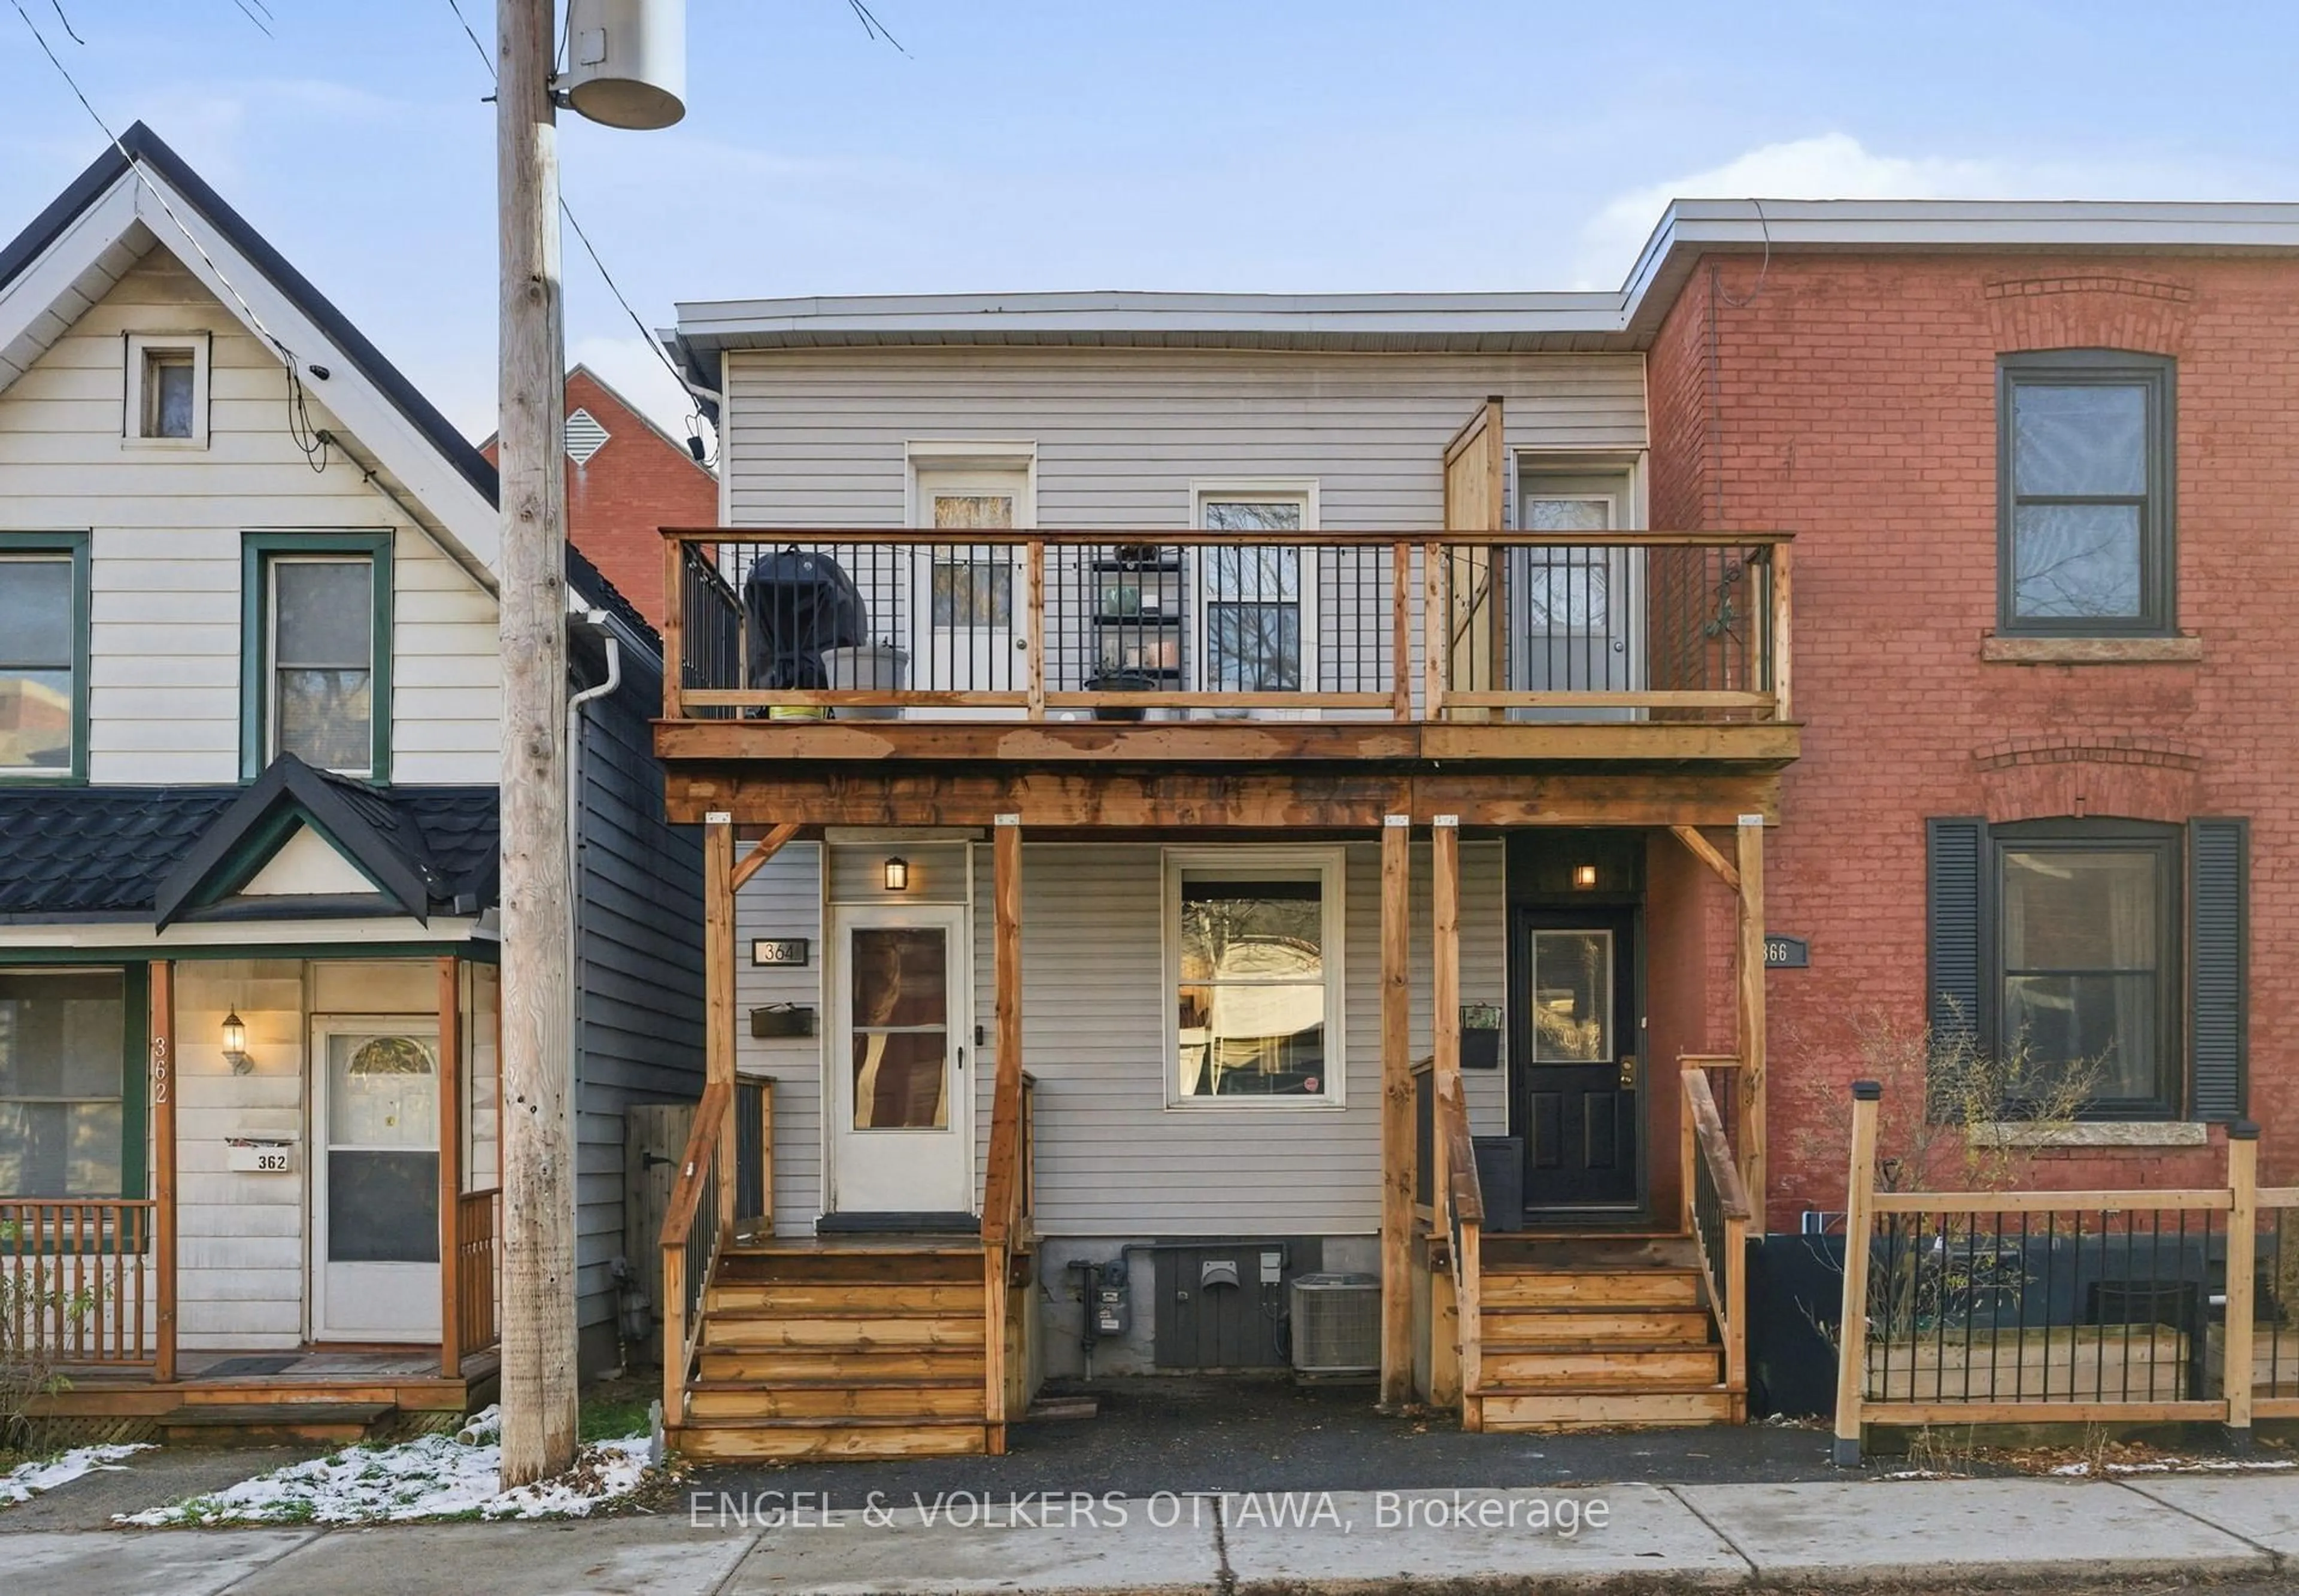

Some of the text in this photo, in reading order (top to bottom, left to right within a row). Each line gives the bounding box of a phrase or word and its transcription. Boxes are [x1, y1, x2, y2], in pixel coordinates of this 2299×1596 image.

[765, 943, 793, 960] 364
[156, 1037, 166, 1102] 362
[258, 1155, 286, 1169] 362
